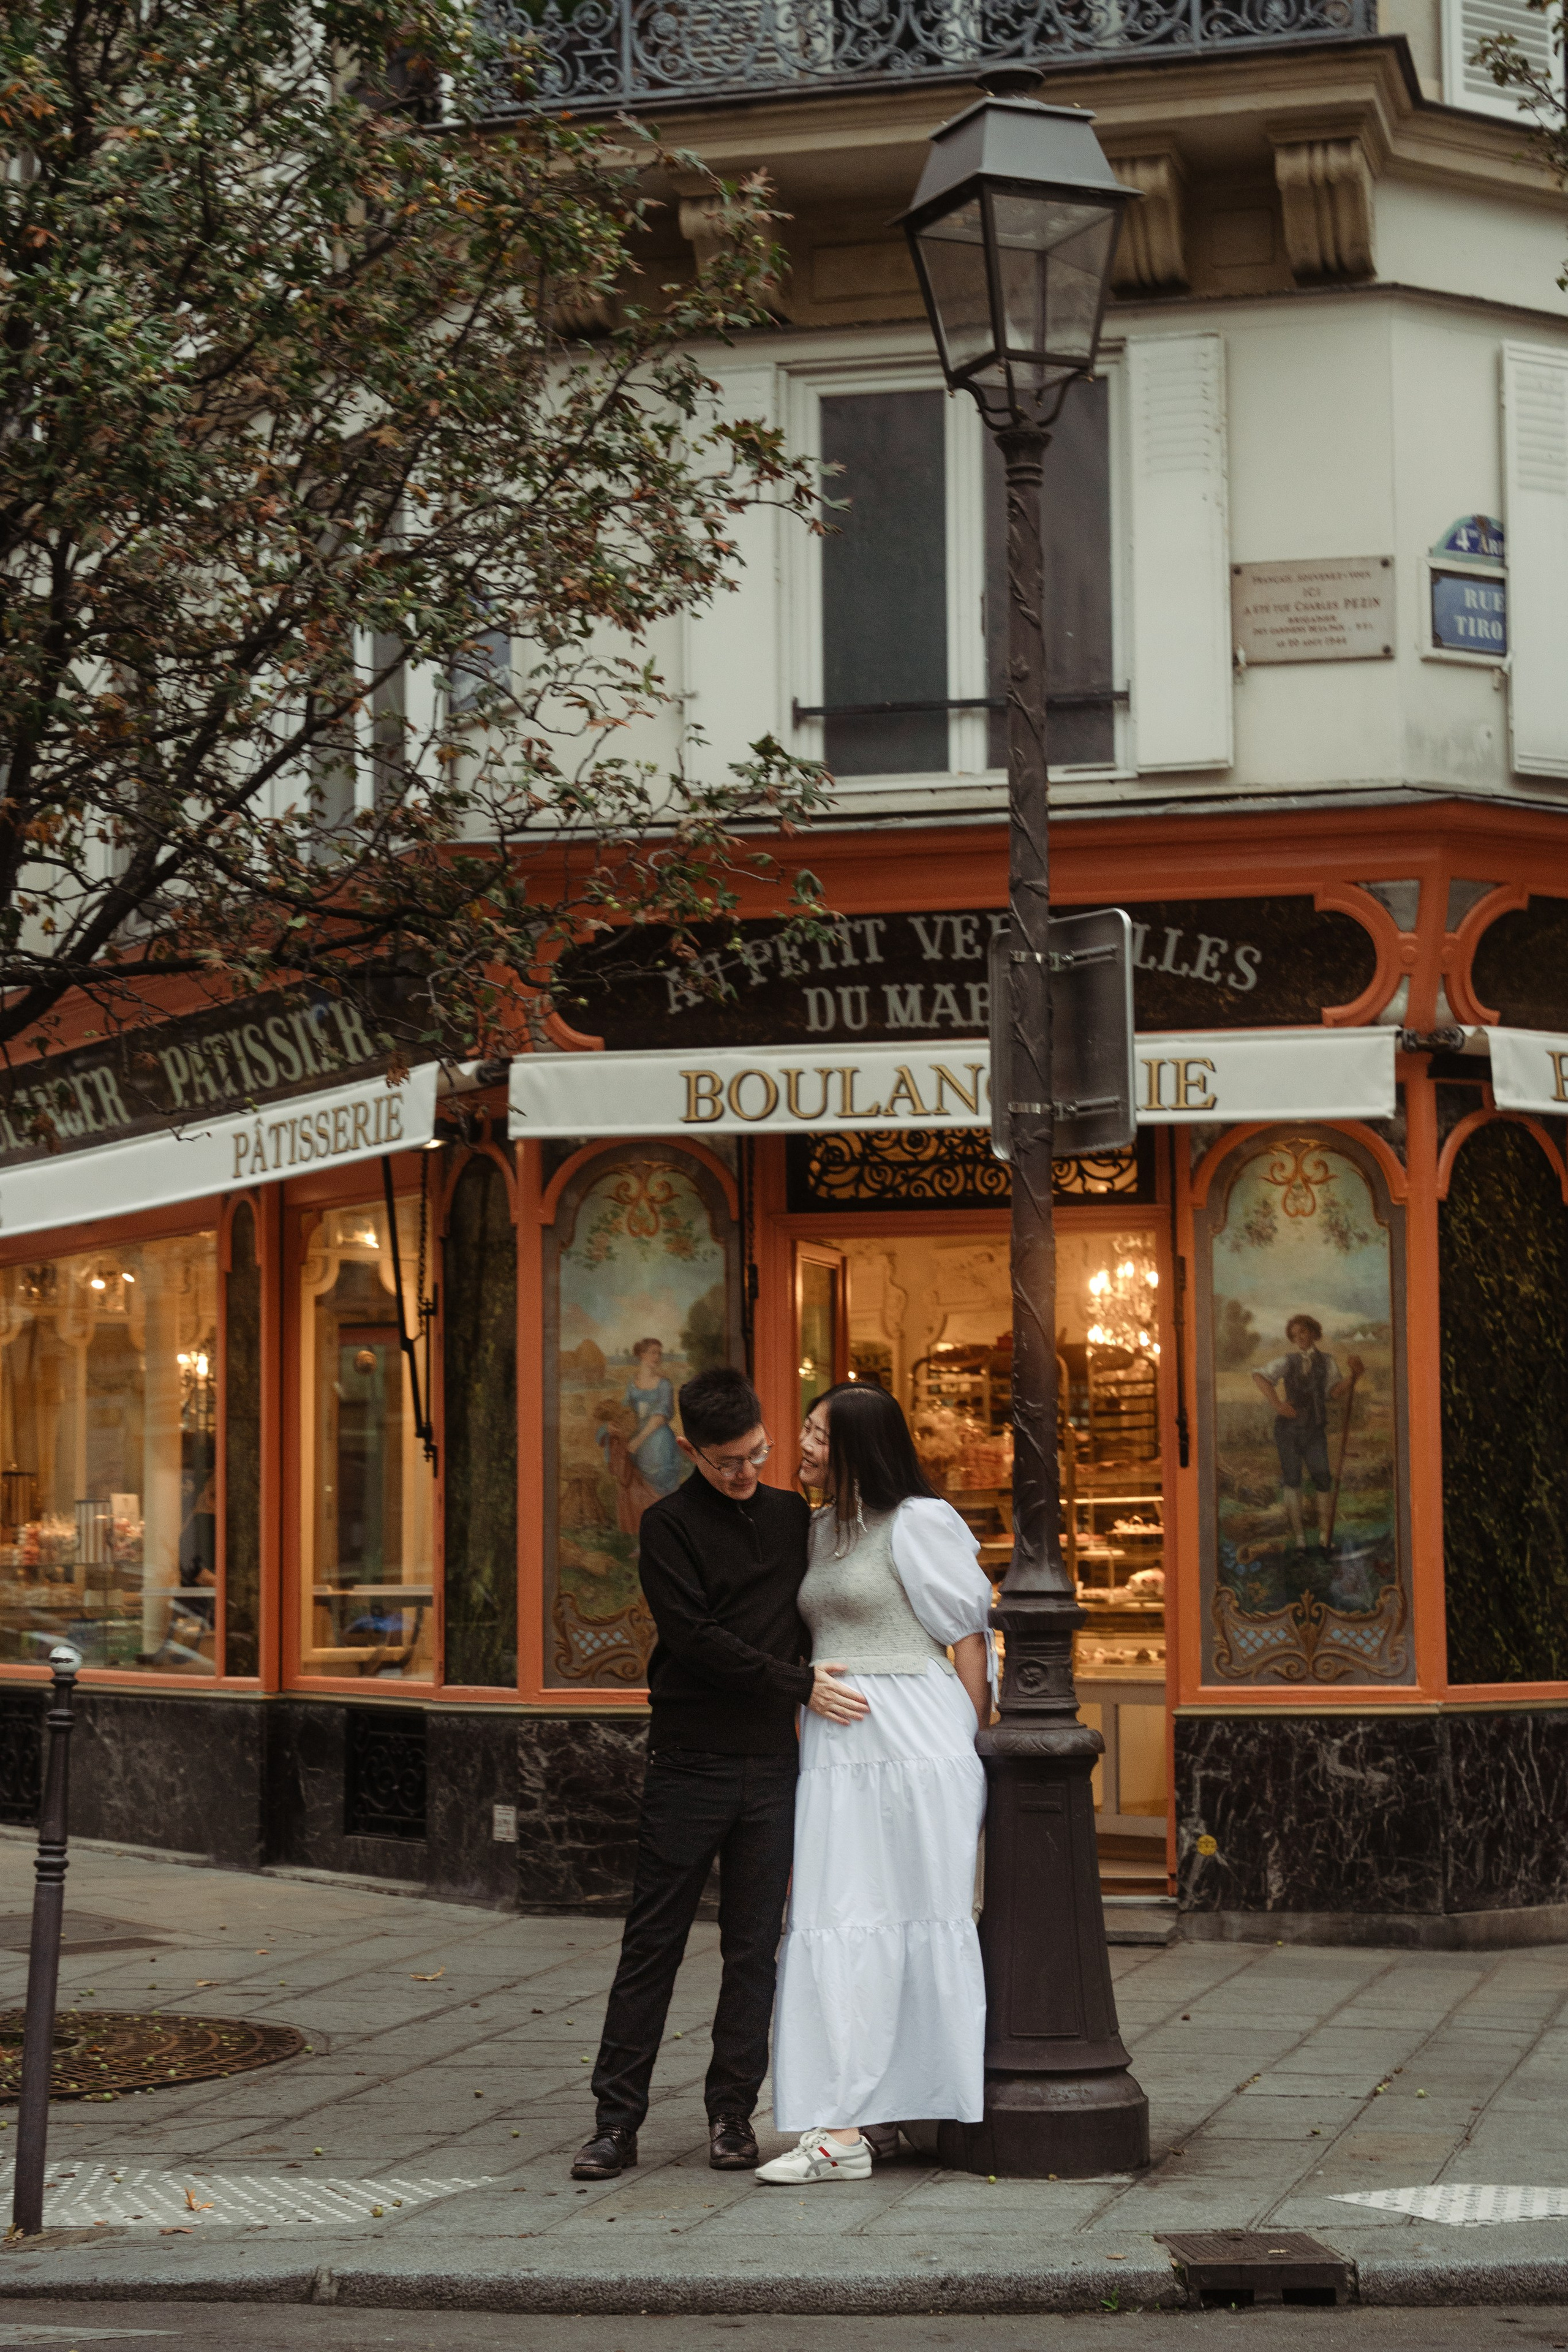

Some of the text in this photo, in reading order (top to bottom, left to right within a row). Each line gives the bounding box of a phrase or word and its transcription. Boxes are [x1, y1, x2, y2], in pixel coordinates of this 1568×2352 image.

[1464, 587, 1504, 612] RUE
[743, 918, 888, 986] PETIT
[907, 911, 1262, 991] VELLES
[802, 984, 871, 1032] DU
[679, 1056, 1217, 1123] BOULANIE
[232, 1091, 405, 1179] PÂTISSERIE
